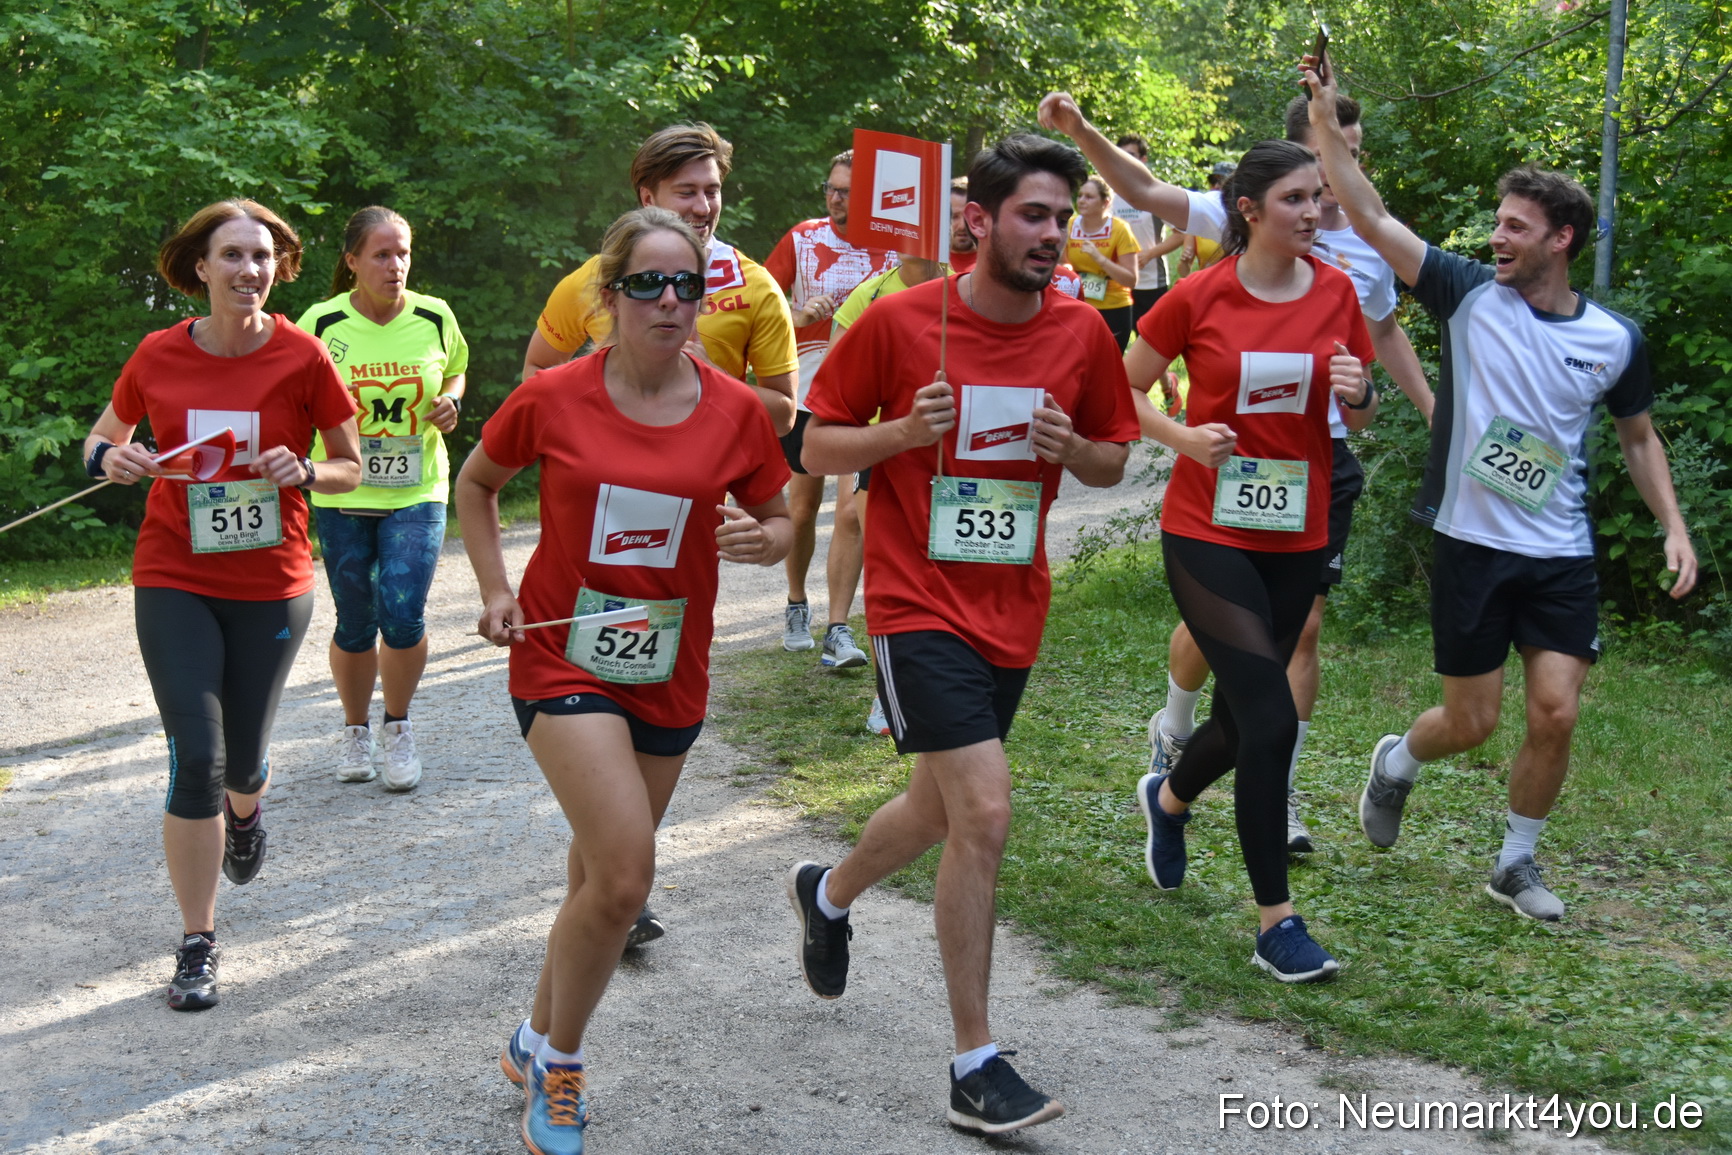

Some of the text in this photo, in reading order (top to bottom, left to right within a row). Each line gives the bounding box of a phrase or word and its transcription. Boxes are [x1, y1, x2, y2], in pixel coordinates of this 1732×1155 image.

[891, 193, 909, 205] DEHN
[870, 221, 893, 234] DEHN
[703, 294, 751, 316] ÖGL
[349, 361, 421, 379] Müller
[1260, 388, 1286, 399] DEHN
[371, 397, 407, 424] M
[985, 430, 1014, 443] DEHN
[368, 456, 409, 475] 673
[1481, 443, 1546, 491] 2280
[1236, 483, 1288, 511] 503
[211, 505, 263, 533] 513
[955, 508, 1016, 541] 533
[220, 531, 259, 542] Lang Birgit
[622, 534, 652, 546] DEHN
[954, 539, 1016, 550] Pröbster Tizian
[594, 626, 660, 660] 524
[590, 655, 656, 670] Münch Cornelia
